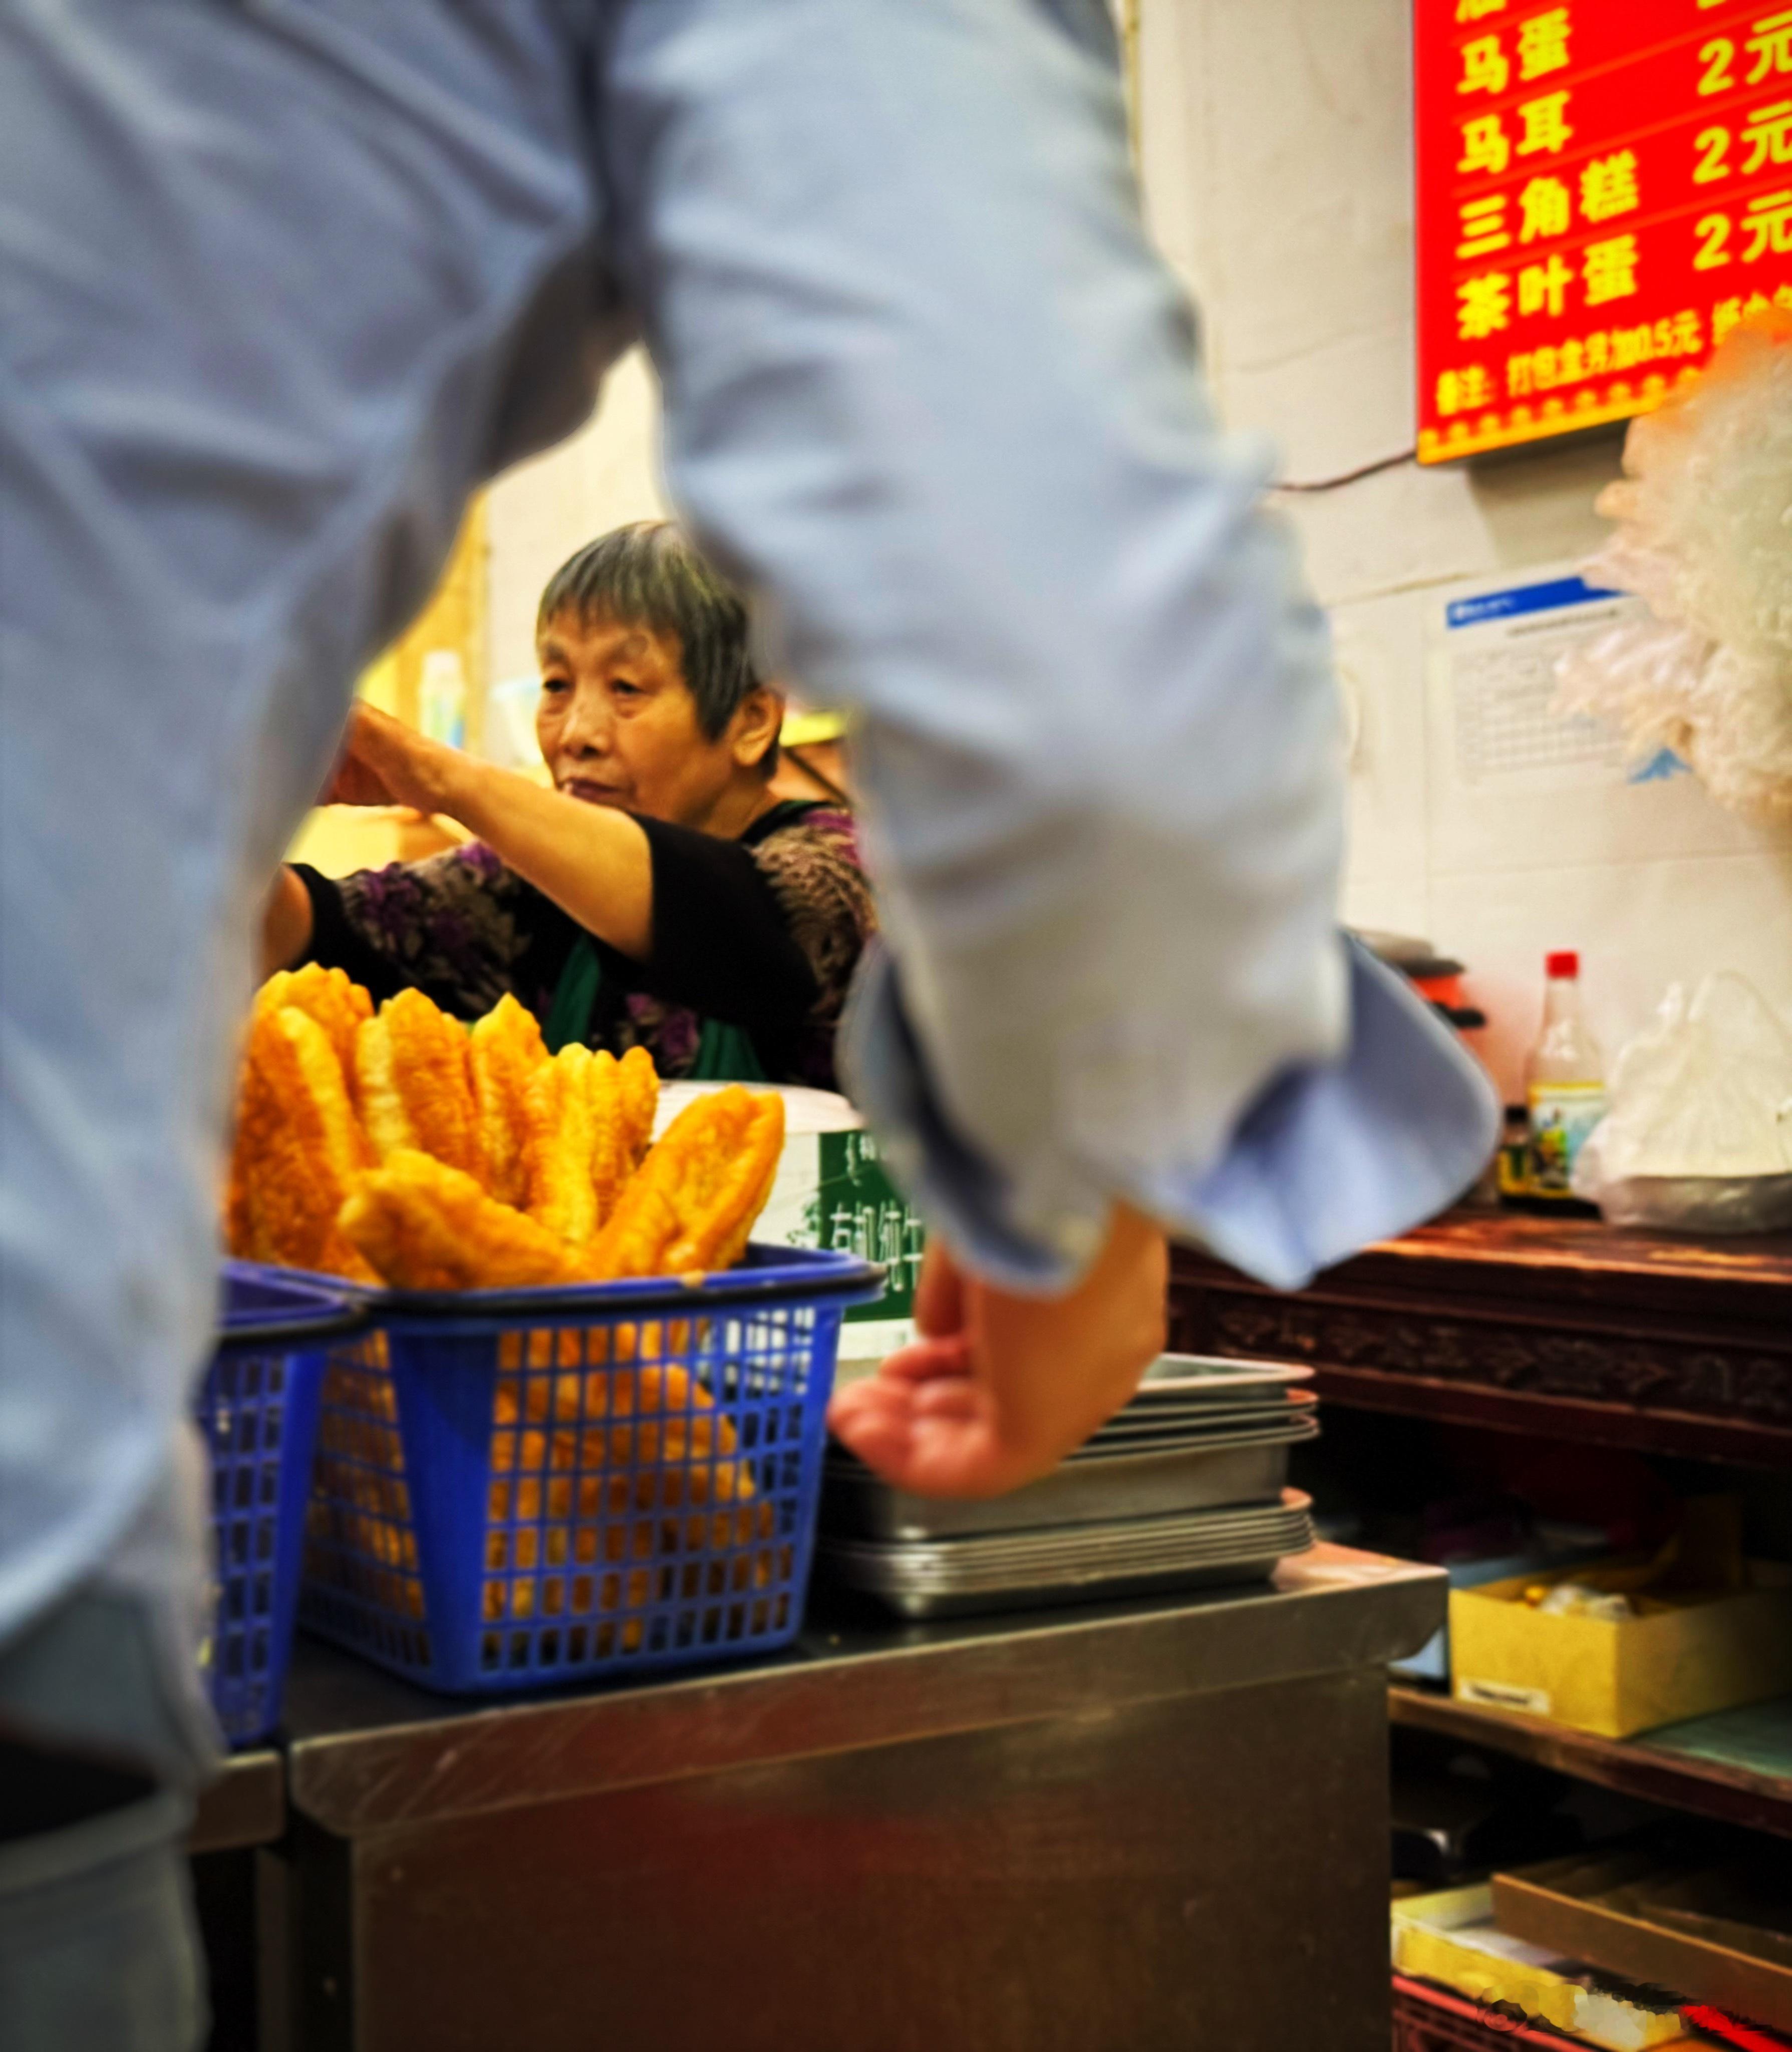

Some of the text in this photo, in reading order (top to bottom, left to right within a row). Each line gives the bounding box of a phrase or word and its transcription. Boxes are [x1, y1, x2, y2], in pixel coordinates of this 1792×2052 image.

[1456, 7, 1572, 94] 马蛋
[1456, 10, 1792, 174] 马耳 2元
[1455, 100, 1792, 259] 三角糕 2元
[1455, 233, 1639, 340] 茶叶蛋
[1693, 189, 1792, 271] 2元
